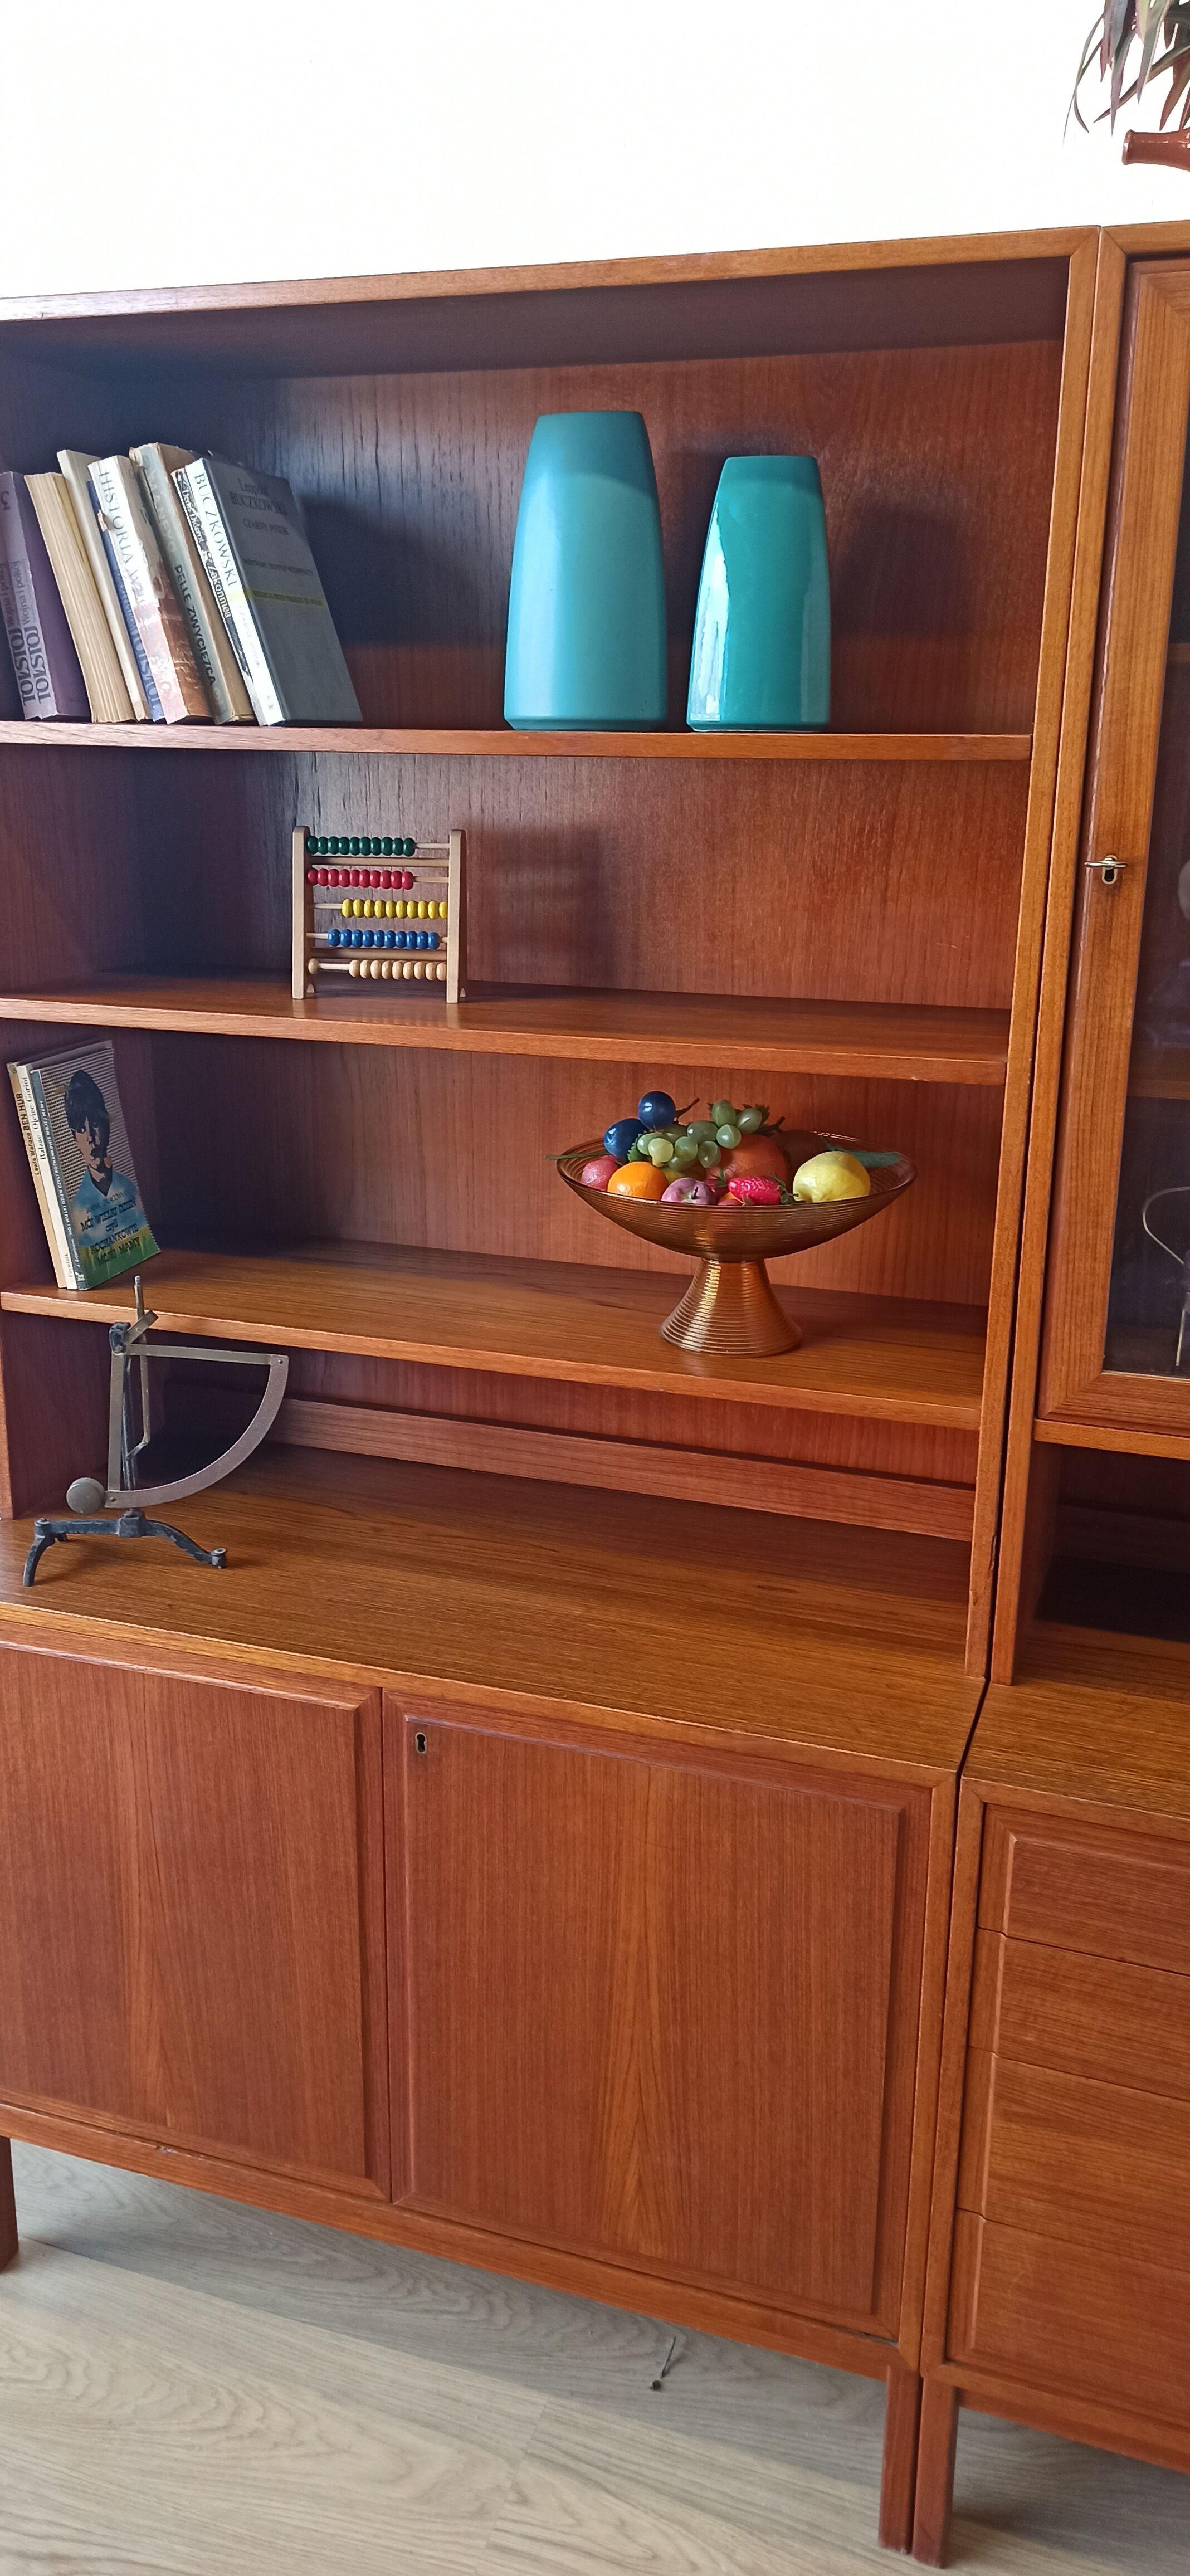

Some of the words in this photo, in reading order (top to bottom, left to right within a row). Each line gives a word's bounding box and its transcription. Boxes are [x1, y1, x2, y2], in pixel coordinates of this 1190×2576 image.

[98, 471, 134, 564] HISTORIA
[194, 472, 238, 587] BUCZKOWSKI
[16, 1093, 26, 1114] HUR
[21, 1114, 30, 1131] BEN
[90, 1223, 139, 1255] KOCHANKOWIE
